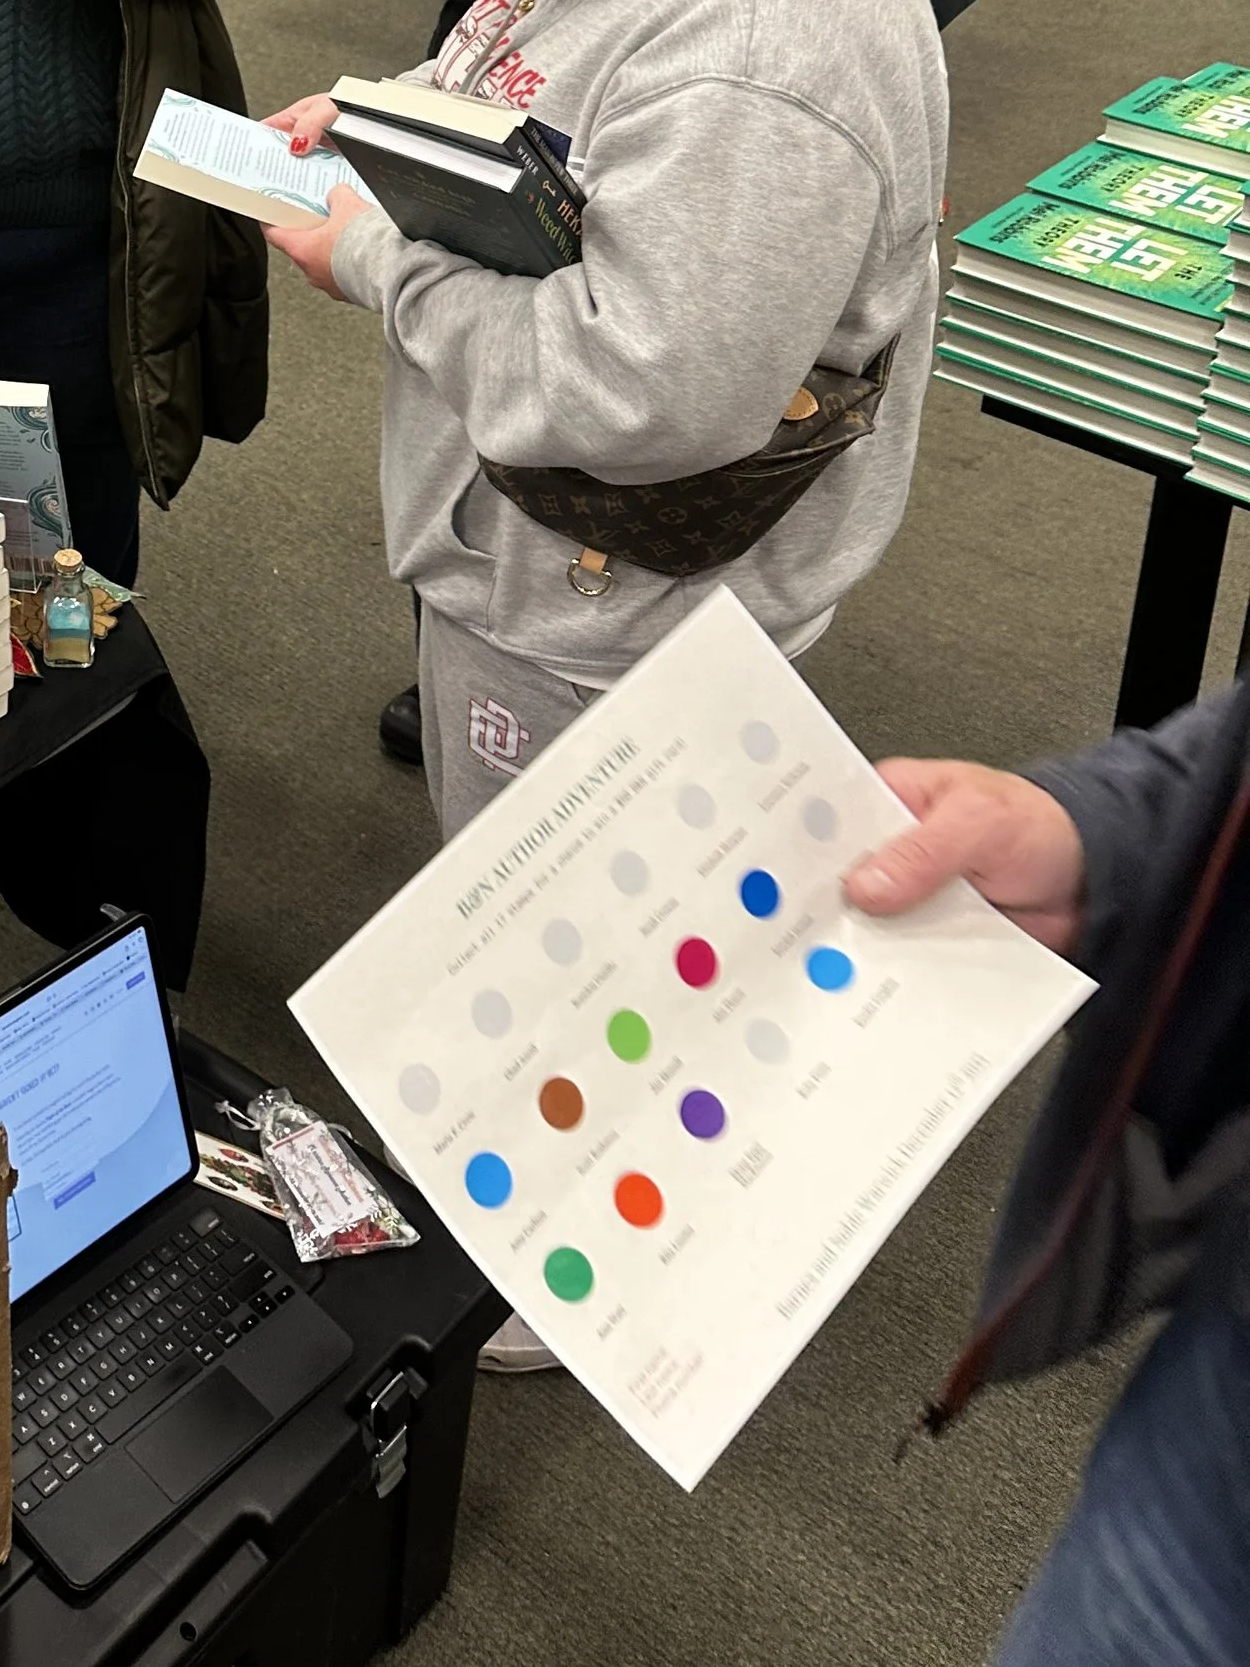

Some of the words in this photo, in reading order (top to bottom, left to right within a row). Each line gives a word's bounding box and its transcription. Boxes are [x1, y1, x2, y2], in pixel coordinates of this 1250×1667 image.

[517, 145, 539, 176] WEBER
[1101, 165, 1146, 193] THEORY
[1108, 165, 1209, 216] THEM
[1175, 184, 1245, 224] LET
[535, 197, 562, 238] Weed
[988, 212, 1042, 243] Robbins
[1032, 216, 1080, 248] THEORY
[1040, 217, 1147, 275] THEM
[1110, 238, 1188, 281] LET
[1174, 263, 1203, 281] THE
[453, 876, 497, 920] B&N
[487, 817, 559, 887] AUTHOR
[546, 734, 643, 829] ADVENTURE
